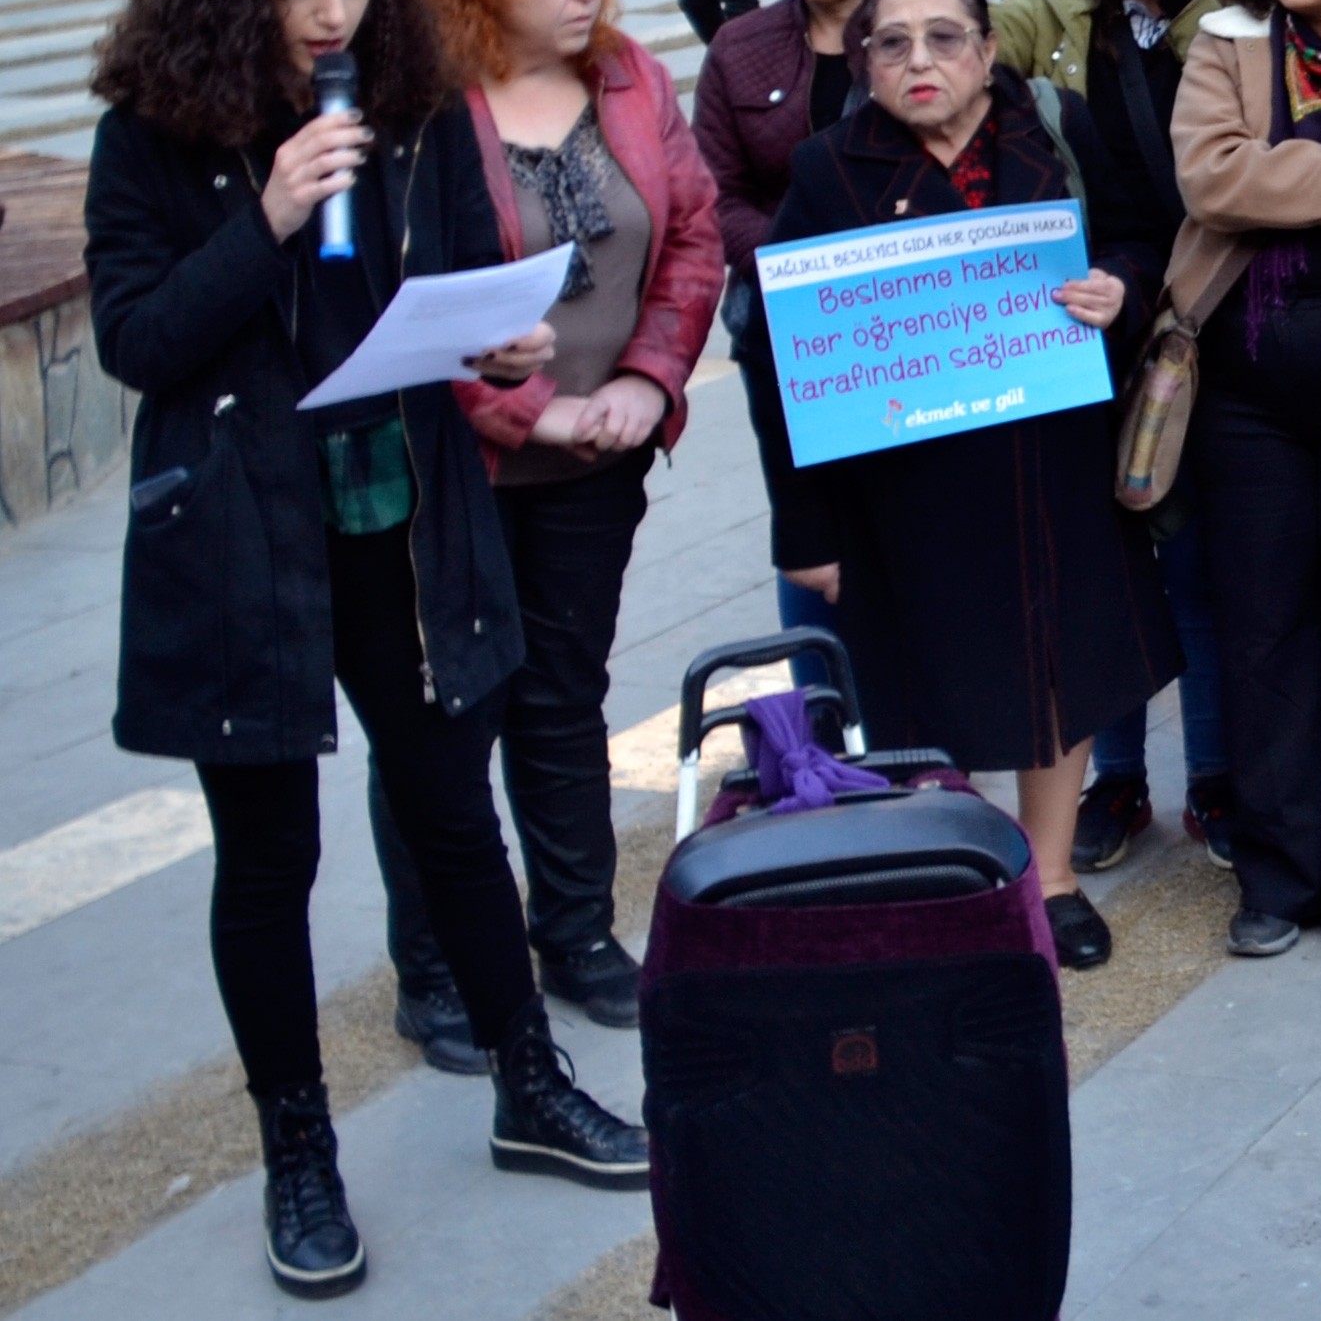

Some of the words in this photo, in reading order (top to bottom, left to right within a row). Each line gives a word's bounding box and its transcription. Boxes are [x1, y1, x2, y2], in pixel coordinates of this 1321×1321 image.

[938, 231, 964, 247] HER
[968, 220, 1029, 246] ÇOCUĞUN
[818, 267, 952, 315] Beslenme
[960, 249, 1039, 284] hakkı
[792, 334, 842, 361] her
[852, 302, 988, 352] öğrenciye
[788, 352, 941, 404] tarafından
[905, 399, 966, 427] ekmek
[971, 394, 992, 414] ve
[995, 387, 1025, 412] gül
